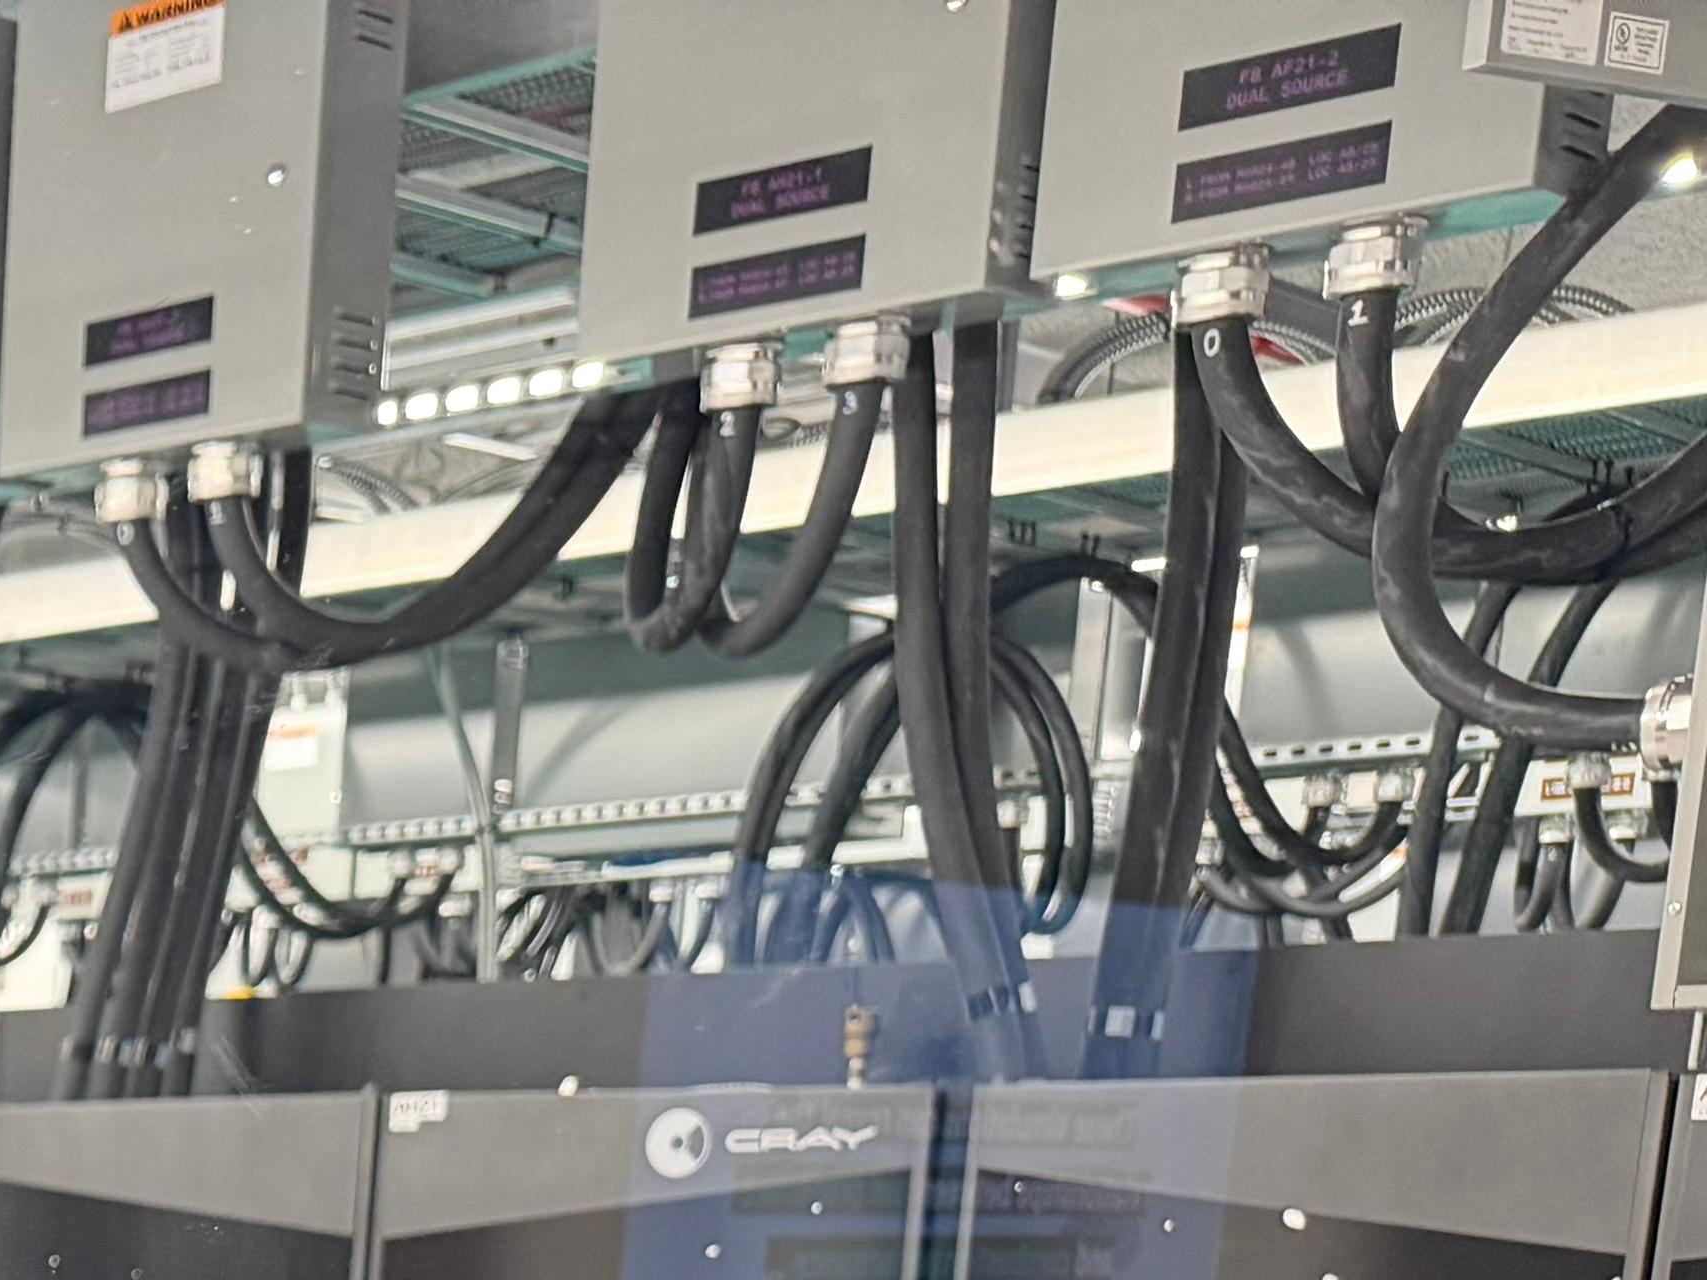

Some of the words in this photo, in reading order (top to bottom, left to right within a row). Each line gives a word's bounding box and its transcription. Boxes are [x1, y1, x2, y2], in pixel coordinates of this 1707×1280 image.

[1280, 68, 1350, 98] SOURCE
[1347, 299, 1369, 327] 1
[842, 390, 858, 416] 3
[719, 410, 735, 437] 2
[725, 1125, 878, 1154] CRAY
